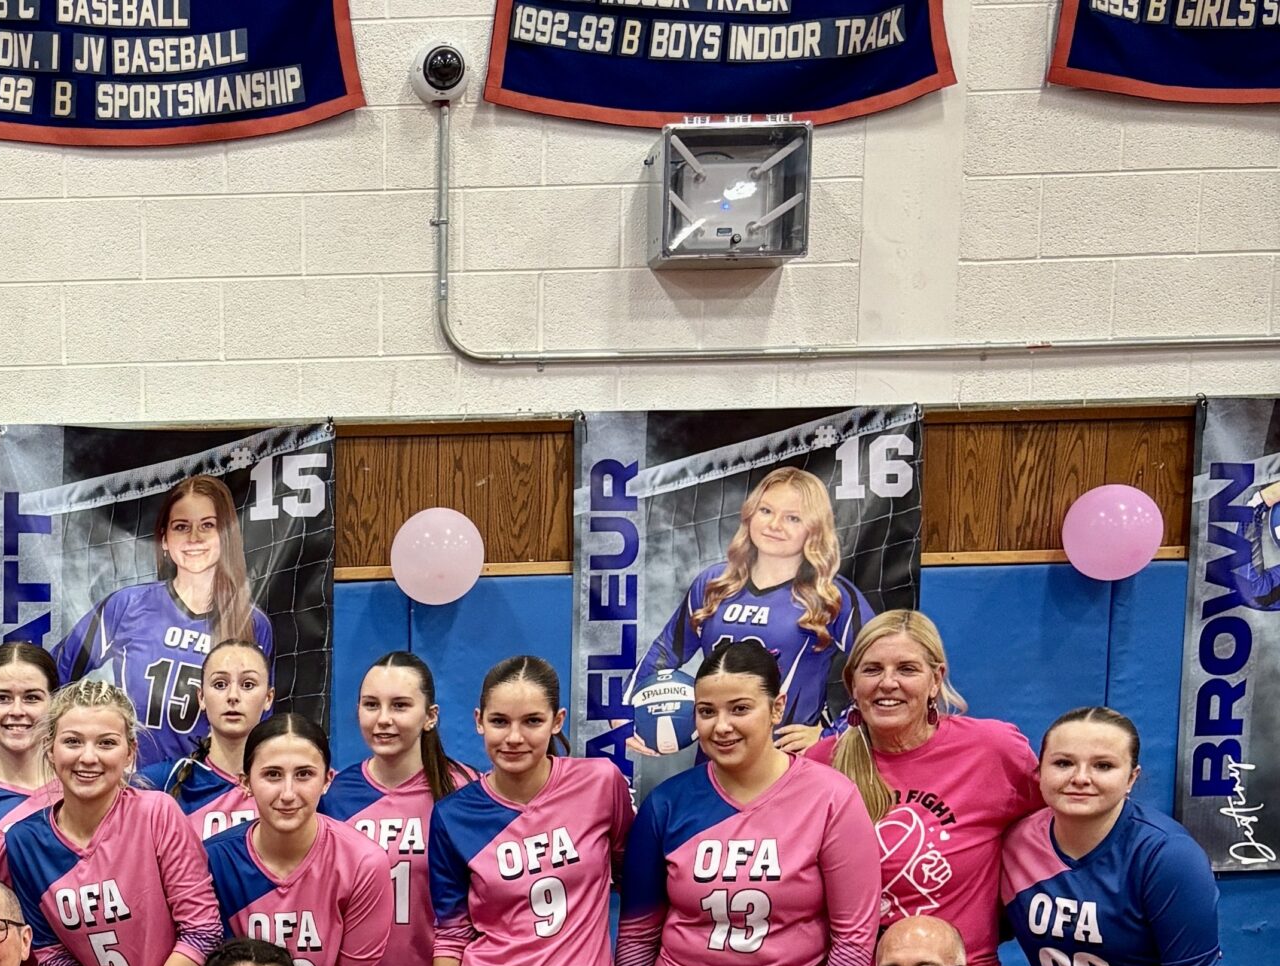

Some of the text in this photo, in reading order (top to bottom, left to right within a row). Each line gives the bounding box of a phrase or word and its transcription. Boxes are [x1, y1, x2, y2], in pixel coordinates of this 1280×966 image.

[57, 0, 189, 27] BASEBALL
[513, 7, 905, 61] 1992-93 B BOYS INDOOR TRACK
[1175, 0, 1256, 27] GIRLS
[74, 36, 104, 73] JV
[113, 30, 247, 74] BASEBALL
[54, 81, 73, 116] B
[97, 67, 302, 119] SPORTSMANSHIP
[231, 447, 327, 522] #15
[813, 425, 914, 501] #16
[164, 626, 211, 655] OFA
[722, 603, 770, 626] OFA
[1191, 461, 1256, 798] BROWN
[145, 657, 203, 734] 15
[642, 686, 687, 702] SPALDING
[905, 789, 957, 826] FIGHT
[354, 817, 426, 855] OFA
[496, 826, 581, 881] OFA
[693, 838, 782, 883] OFA
[54, 878, 132, 930] OFA
[529, 876, 568, 939] 9
[700, 888, 772, 954] 13
[1028, 893, 1104, 945] OFA
[247, 910, 323, 952] OFA
